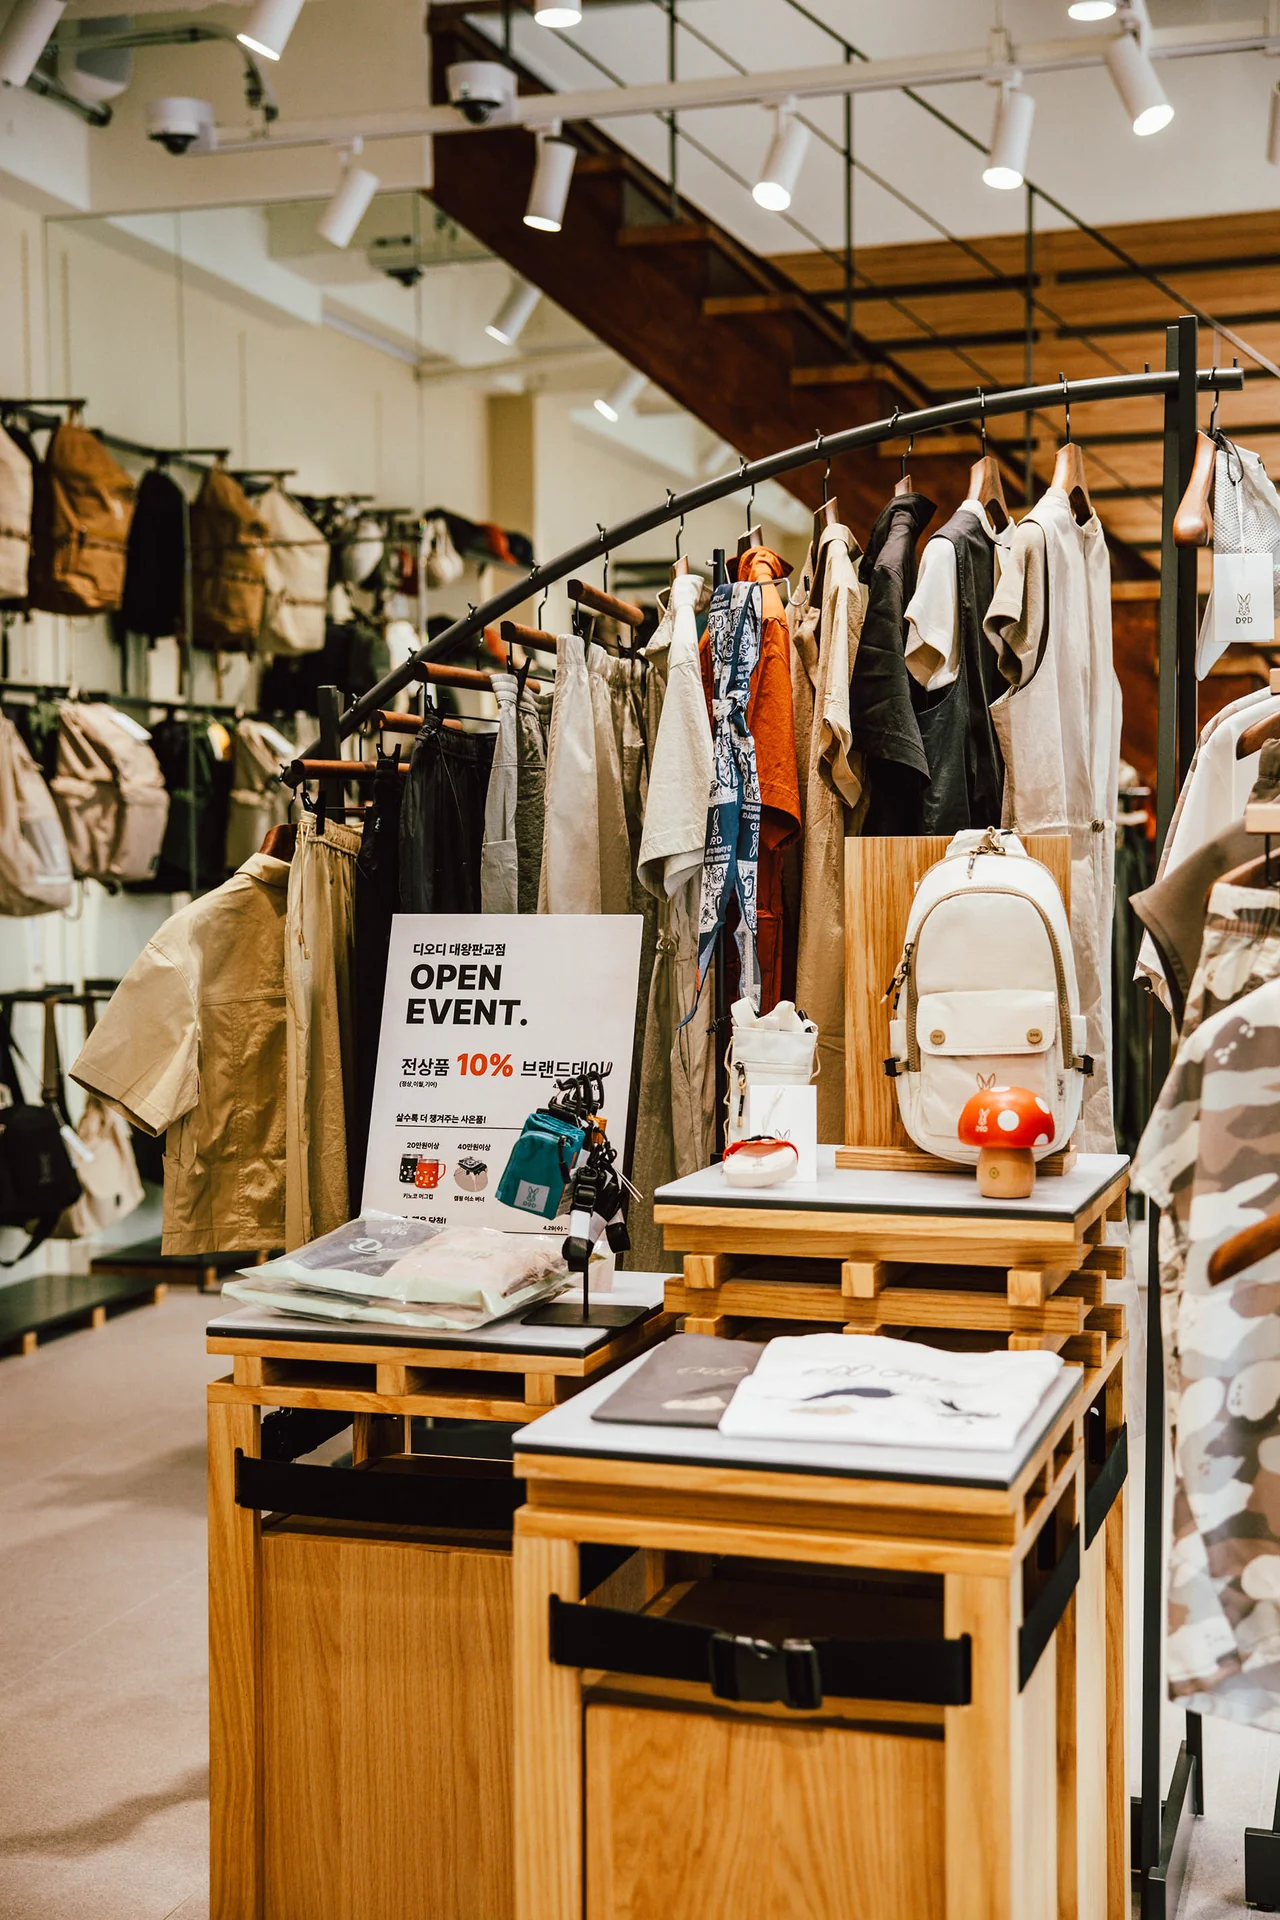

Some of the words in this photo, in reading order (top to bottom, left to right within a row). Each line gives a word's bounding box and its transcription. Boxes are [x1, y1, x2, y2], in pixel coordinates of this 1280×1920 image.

[1235, 616, 1253, 624] DOD
[413, 943, 446, 956] 디오디
[449, 943, 506, 956] 대왕판교점
[410, 963, 502, 990] OPEN
[406, 998, 528, 1026] EVENT.
[401, 1058, 450, 1076] 전상품
[456, 1053, 513, 1077] 10%
[520, 1060, 604, 1078] 브랜드데이
[396, 1113, 418, 1123] 살수록
[420, 1114, 428, 1123] 더
[429, 1114, 459, 1124] 챙겨주는
[461, 1115, 486, 1125] 사은품!
[406, 1142, 440, 1150] 20만원이상
[457, 1143, 491, 1151] 40만원이상
